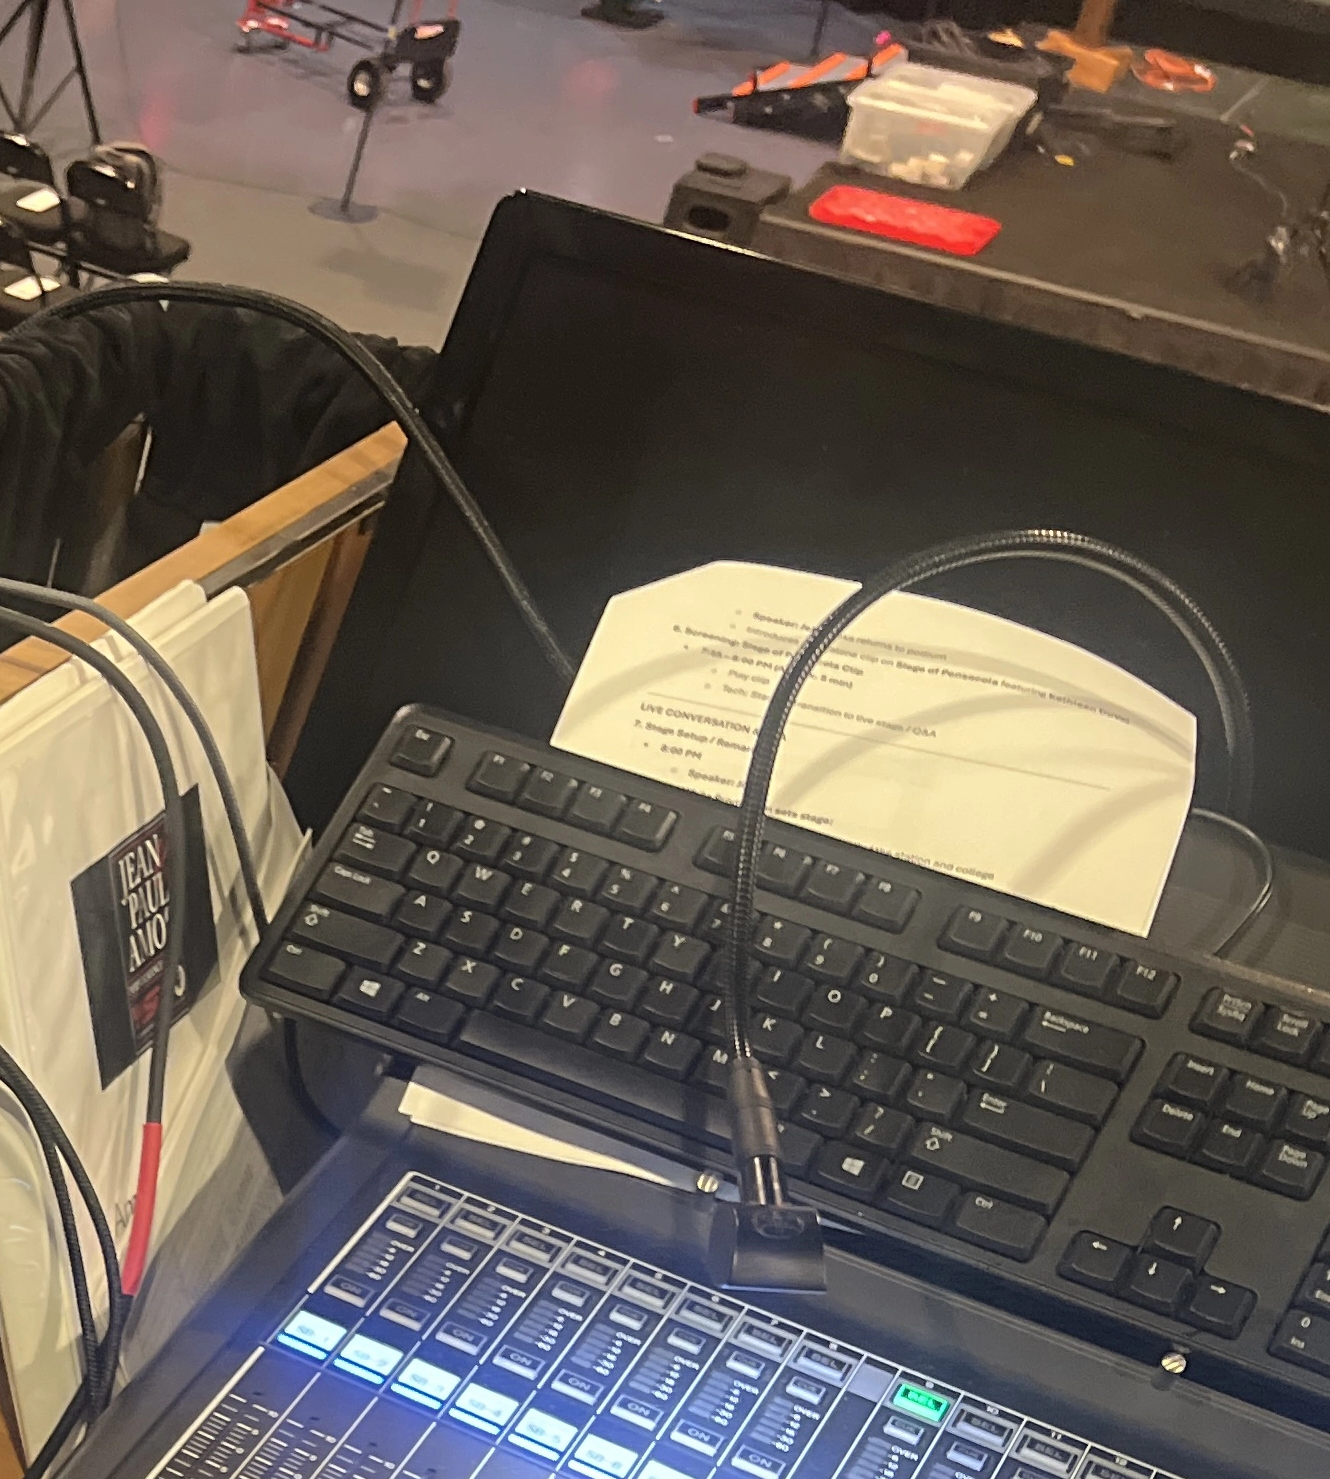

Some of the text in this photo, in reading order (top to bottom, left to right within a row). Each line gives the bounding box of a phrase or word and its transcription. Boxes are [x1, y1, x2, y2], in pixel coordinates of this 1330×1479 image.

[641, 702, 751, 734] LIVE CONVERSATION
[685, 749, 703, 760] PM
[426, 850, 440, 865] Q
[118, 833, 163, 906] JEAN
[475, 865, 493, 881] W
[520, 882, 533, 896] E
[127, 871, 170, 930] PAUL
[413, 895, 426, 908] A
[571, 899, 583, 913] R
[460, 910, 473, 923] S
[622, 917, 635, 930] T
[129, 906, 170, 973] AMO
[673, 934, 686, 947] Y
[413, 941, 427, 955] Z
[558, 944, 571, 956] F
[461, 959, 477, 974] X
[609, 963, 623, 977] G
[511, 977, 524, 991] C
[659, 980, 674, 995] H
[562, 994, 576, 1008] V
[879, 1006, 893, 1019] P
[762, 1017, 777, 1032] K
[660, 1030, 676, 1045] N
[712, 1049, 729, 1065] M
[688, 1427, 711, 1442] ON
